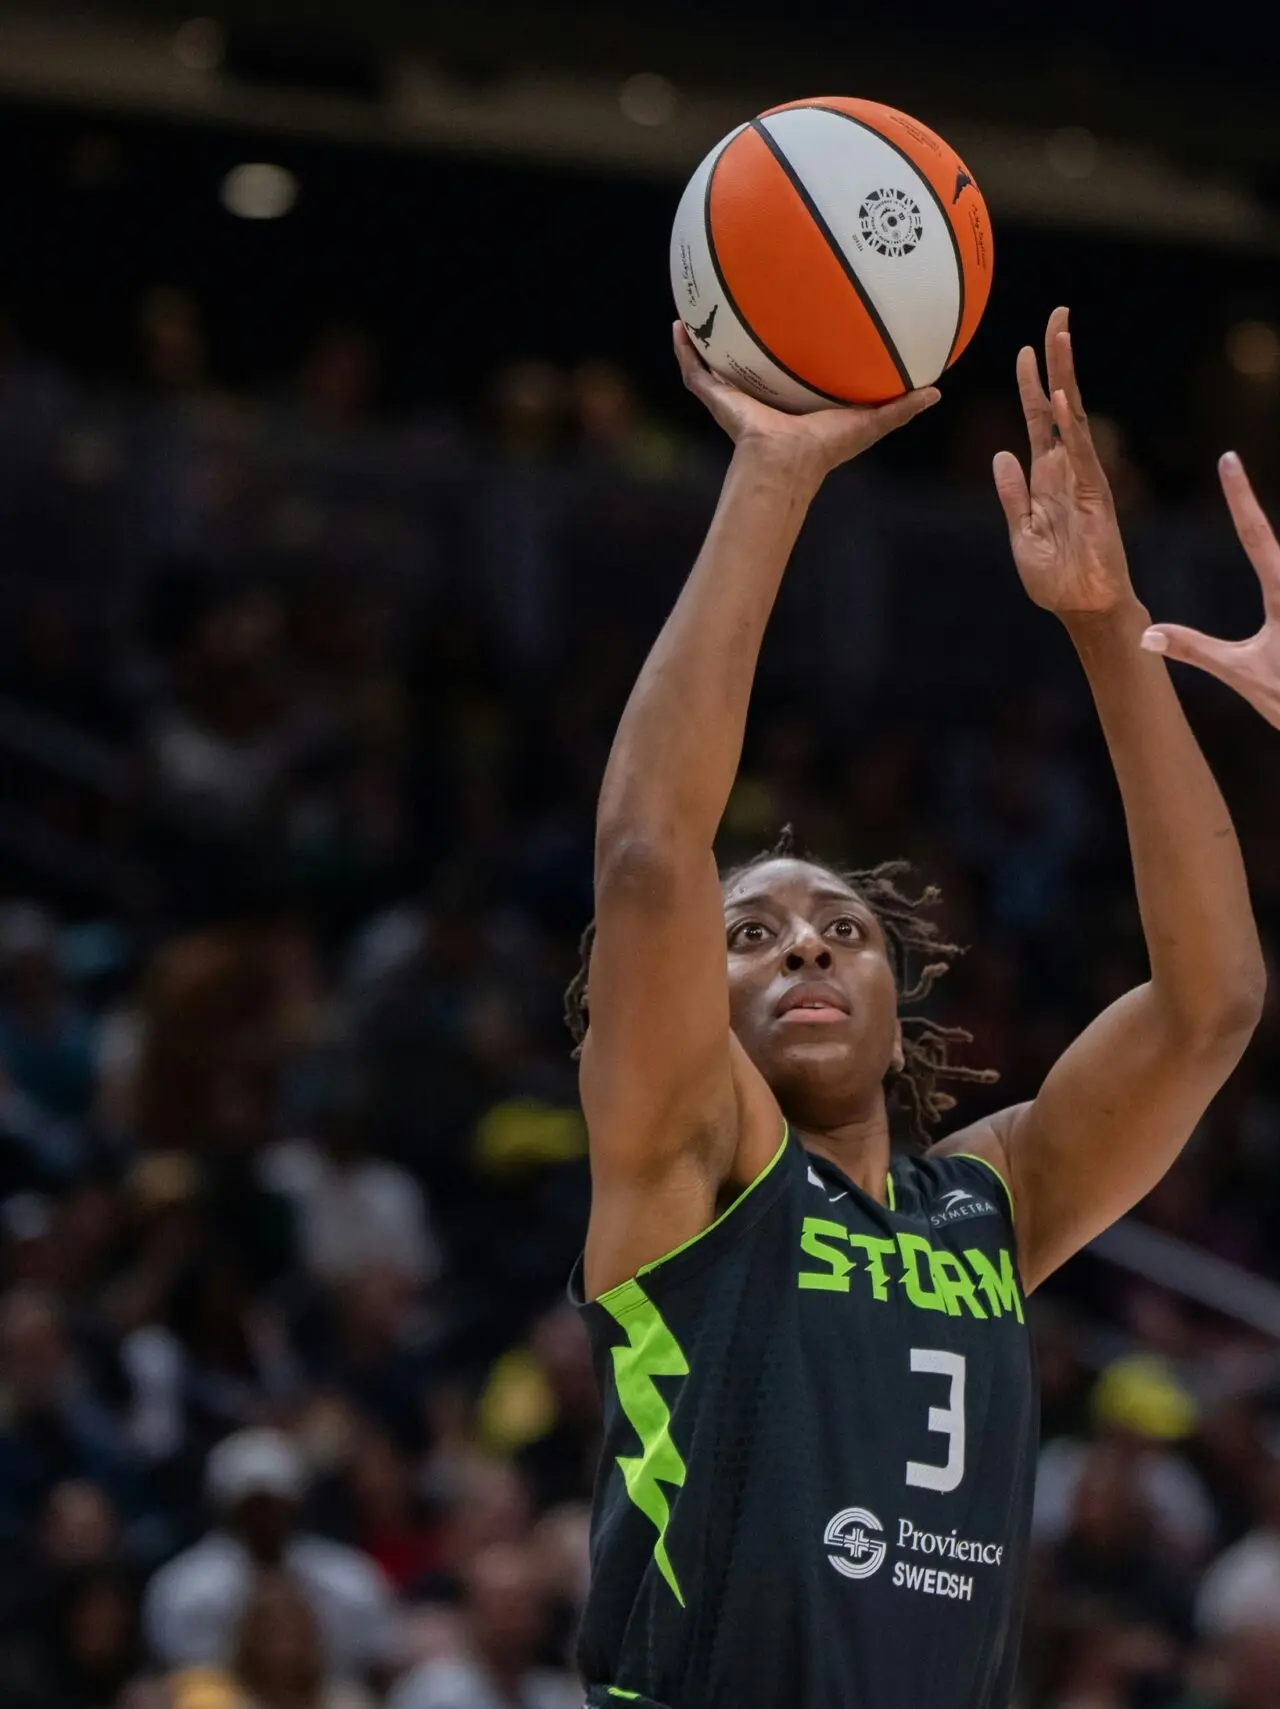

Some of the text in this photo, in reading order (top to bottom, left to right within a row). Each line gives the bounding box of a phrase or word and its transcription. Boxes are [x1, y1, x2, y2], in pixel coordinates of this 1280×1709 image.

[930, 1201, 994, 1227] SYMETRA
[798, 1216, 1025, 1325] STORM
[906, 1348, 966, 1493] 3
[896, 1518, 1004, 1567] Provience
[892, 1561, 973, 1601] SWEDSH
